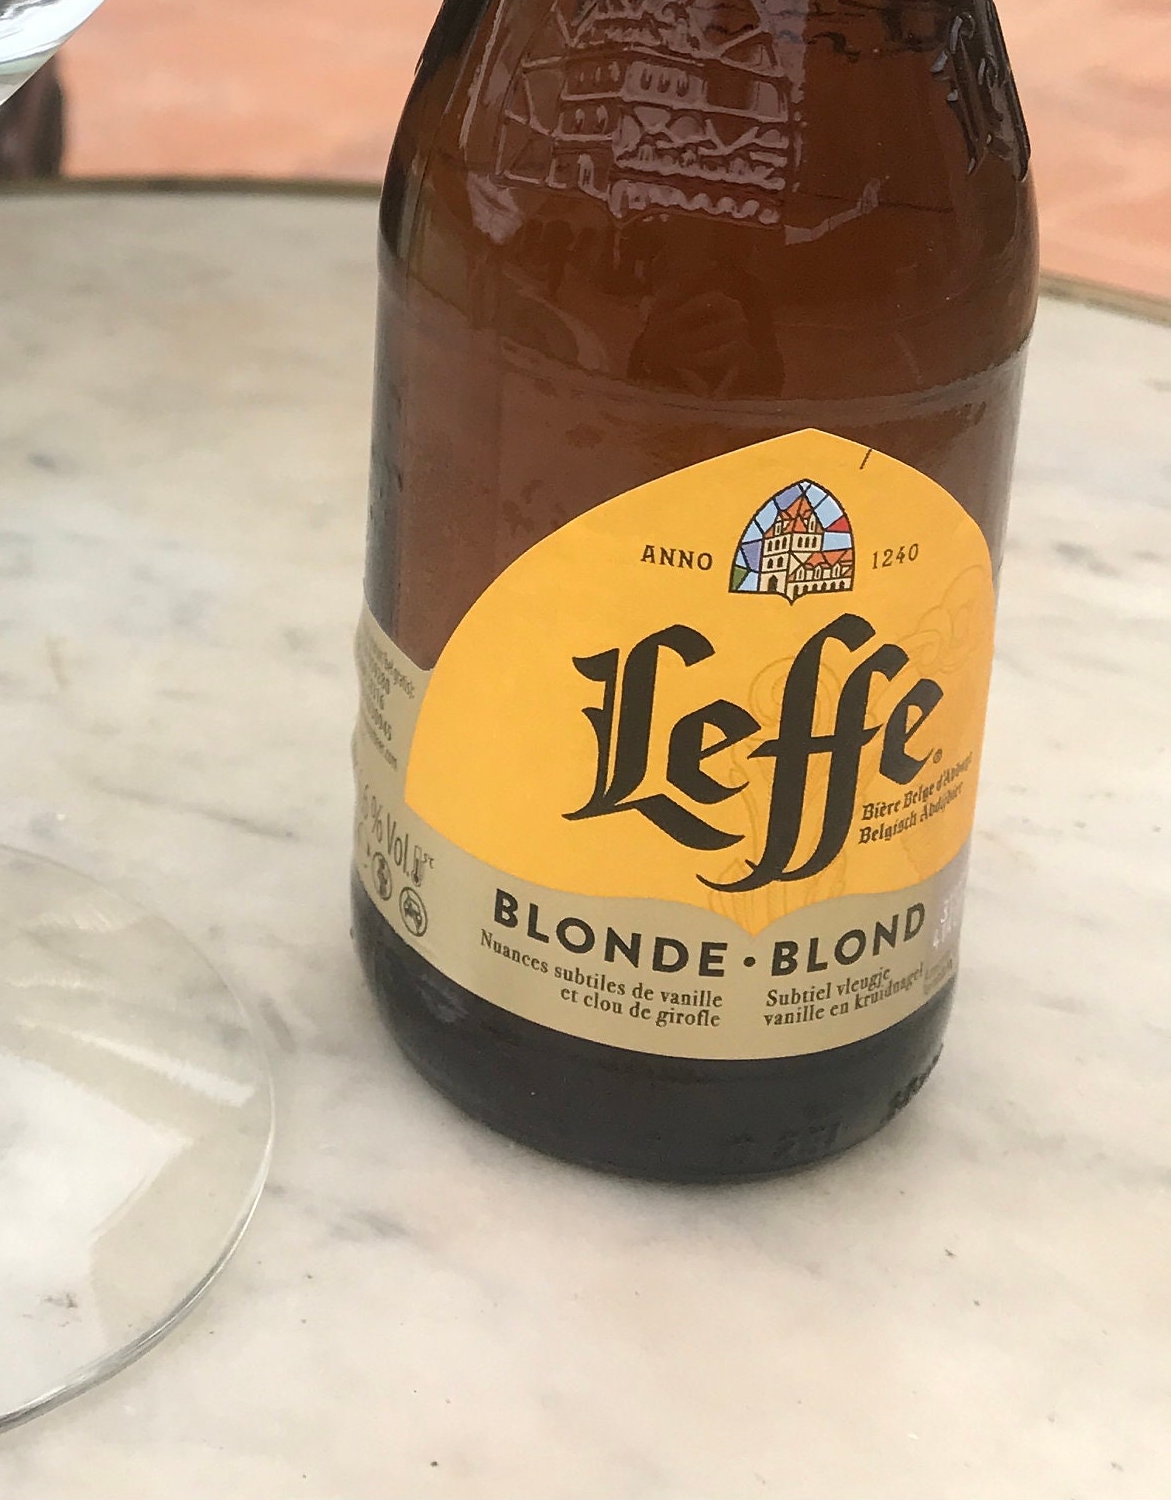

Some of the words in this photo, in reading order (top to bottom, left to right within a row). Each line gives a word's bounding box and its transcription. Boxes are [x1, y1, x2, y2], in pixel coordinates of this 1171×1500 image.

[640, 544, 713, 571] ANNO
[871, 543, 920, 570] 1240
[561, 612, 945, 893] Leffe
[861, 800, 901, 821] Bière
[903, 784, 935, 809] Belge
[386, 812, 410, 877] Vol.
[858, 811, 917, 845] Belgisch
[494, 889, 728, 978] BLONDE
[771, 902, 926, 977] BLOND
[480, 929, 549, 973] Nuances
[553, 964, 626, 996] subtiles
[631, 982, 655, 1002] de
[660, 990, 723, 1008] vanille
[766, 982, 832, 1007] Subtiel
[837, 967, 891, 997] vleugje
[560, 986, 579, 1004] et
[583, 992, 623, 1014] clou
[629, 1001, 651, 1019] de
[655, 1007, 721, 1028] girofle
[764, 1004, 825, 1026] vanille
[830, 1001, 850, 1017] en
